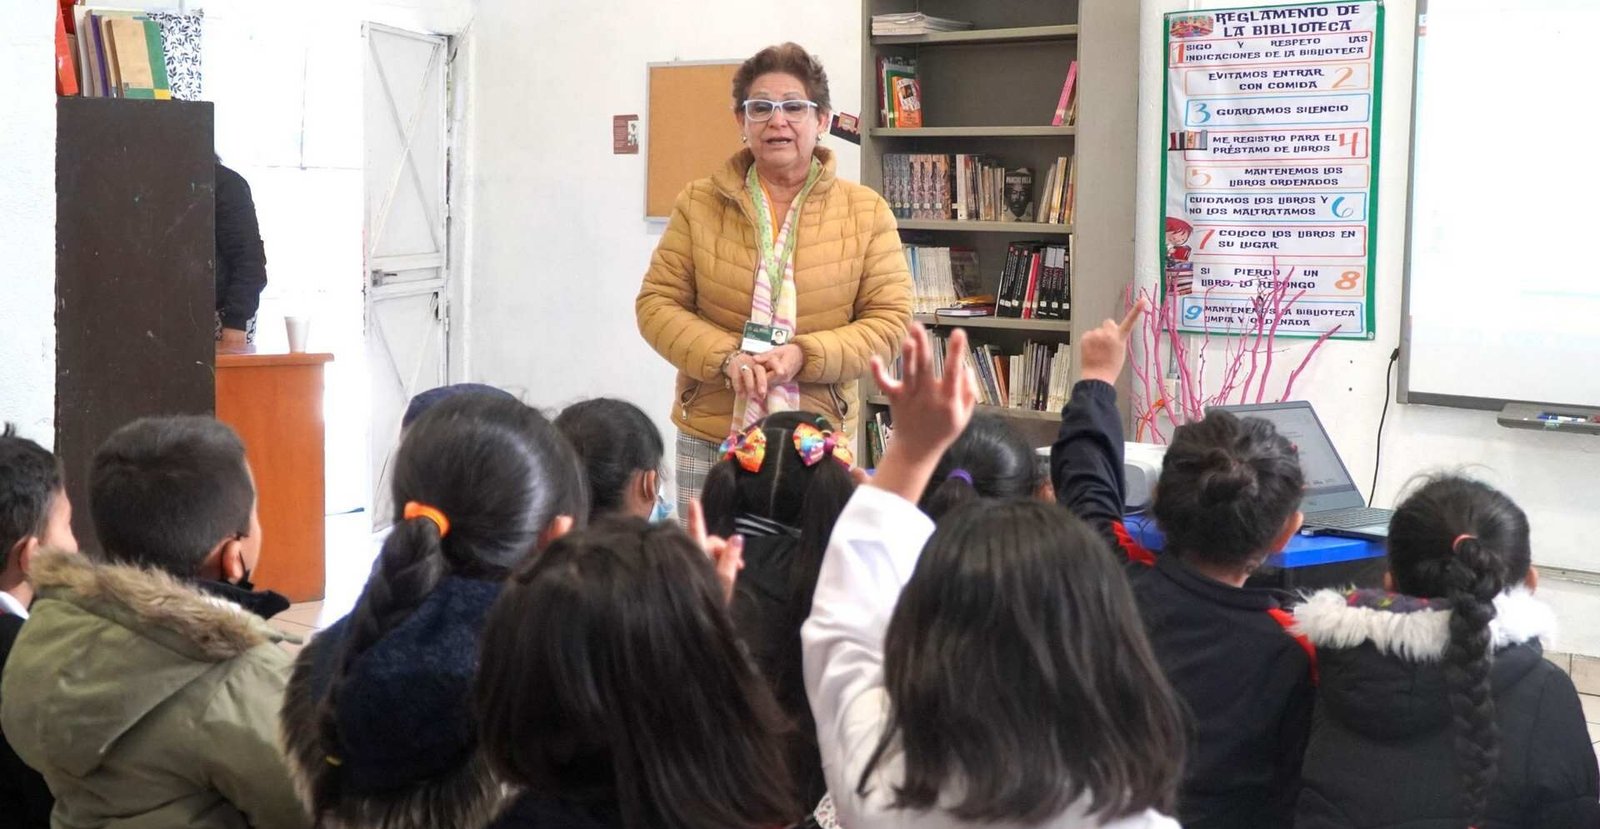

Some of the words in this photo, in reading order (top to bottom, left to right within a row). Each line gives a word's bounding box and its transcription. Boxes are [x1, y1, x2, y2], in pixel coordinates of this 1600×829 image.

[1216, 7, 1329, 25] REGLAMENTO
[1337, 5, 1360, 14] DE
[1224, 26, 1244, 37] LA
[1253, 20, 1352, 35] BIBLIOTECA
[1271, 38, 1321, 46] RESPETO
[1172, 43, 1184, 63] 1
[1186, 52, 1260, 61] INDICACIONES
[1284, 50, 1295, 58] LA
[1300, 47, 1364, 56] BIBLIOTECA
[1208, 71, 1268, 80] EVITAMOS
[1273, 69, 1324, 78] ENTRAR
[1332, 67, 1359, 88] 2
[1239, 82, 1262, 90] CON
[1268, 81, 1317, 89] COMIDA
[1192, 103, 1210, 123] 3
[1216, 107, 1291, 115] GUARDAMOS
[1297, 105, 1348, 114] SILENCIO
[1234, 135, 1285, 143] REGISTRO
[1325, 134, 1338, 142] EL
[1213, 145, 1270, 154] PRÉSTAMO
[1294, 145, 1330, 153] LIBROS
[1339, 133, 1359, 156] 4
[1324, 167, 1343, 175] LOS
[1189, 169, 1211, 186] 5
[1230, 179, 1265, 187] LIBROS
[1270, 178, 1338, 186] ORDENADOS
[1320, 196, 1328, 204] Y
[1233, 208, 1315, 216] MALTRATAMOS
[1332, 197, 1354, 217] 6
[1196, 229, 1215, 249] 7
[1219, 230, 1266, 238] COLOCO
[1272, 230, 1292, 238] LOS
[1298, 230, 1335, 238] LIBROS
[1341, 230, 1356, 238] EN
[1240, 241, 1279, 249] LUGAR
[1201, 267, 1210, 275] SI
[1234, 268, 1280, 277] PIERDO
[1240, 280, 1252, 288] LO
[1335, 271, 1360, 290] 8
[1185, 306, 1202, 320] 9
[1297, 308, 1355, 317] BIBLIOTECA
[1238, 316, 1245, 324] Y
